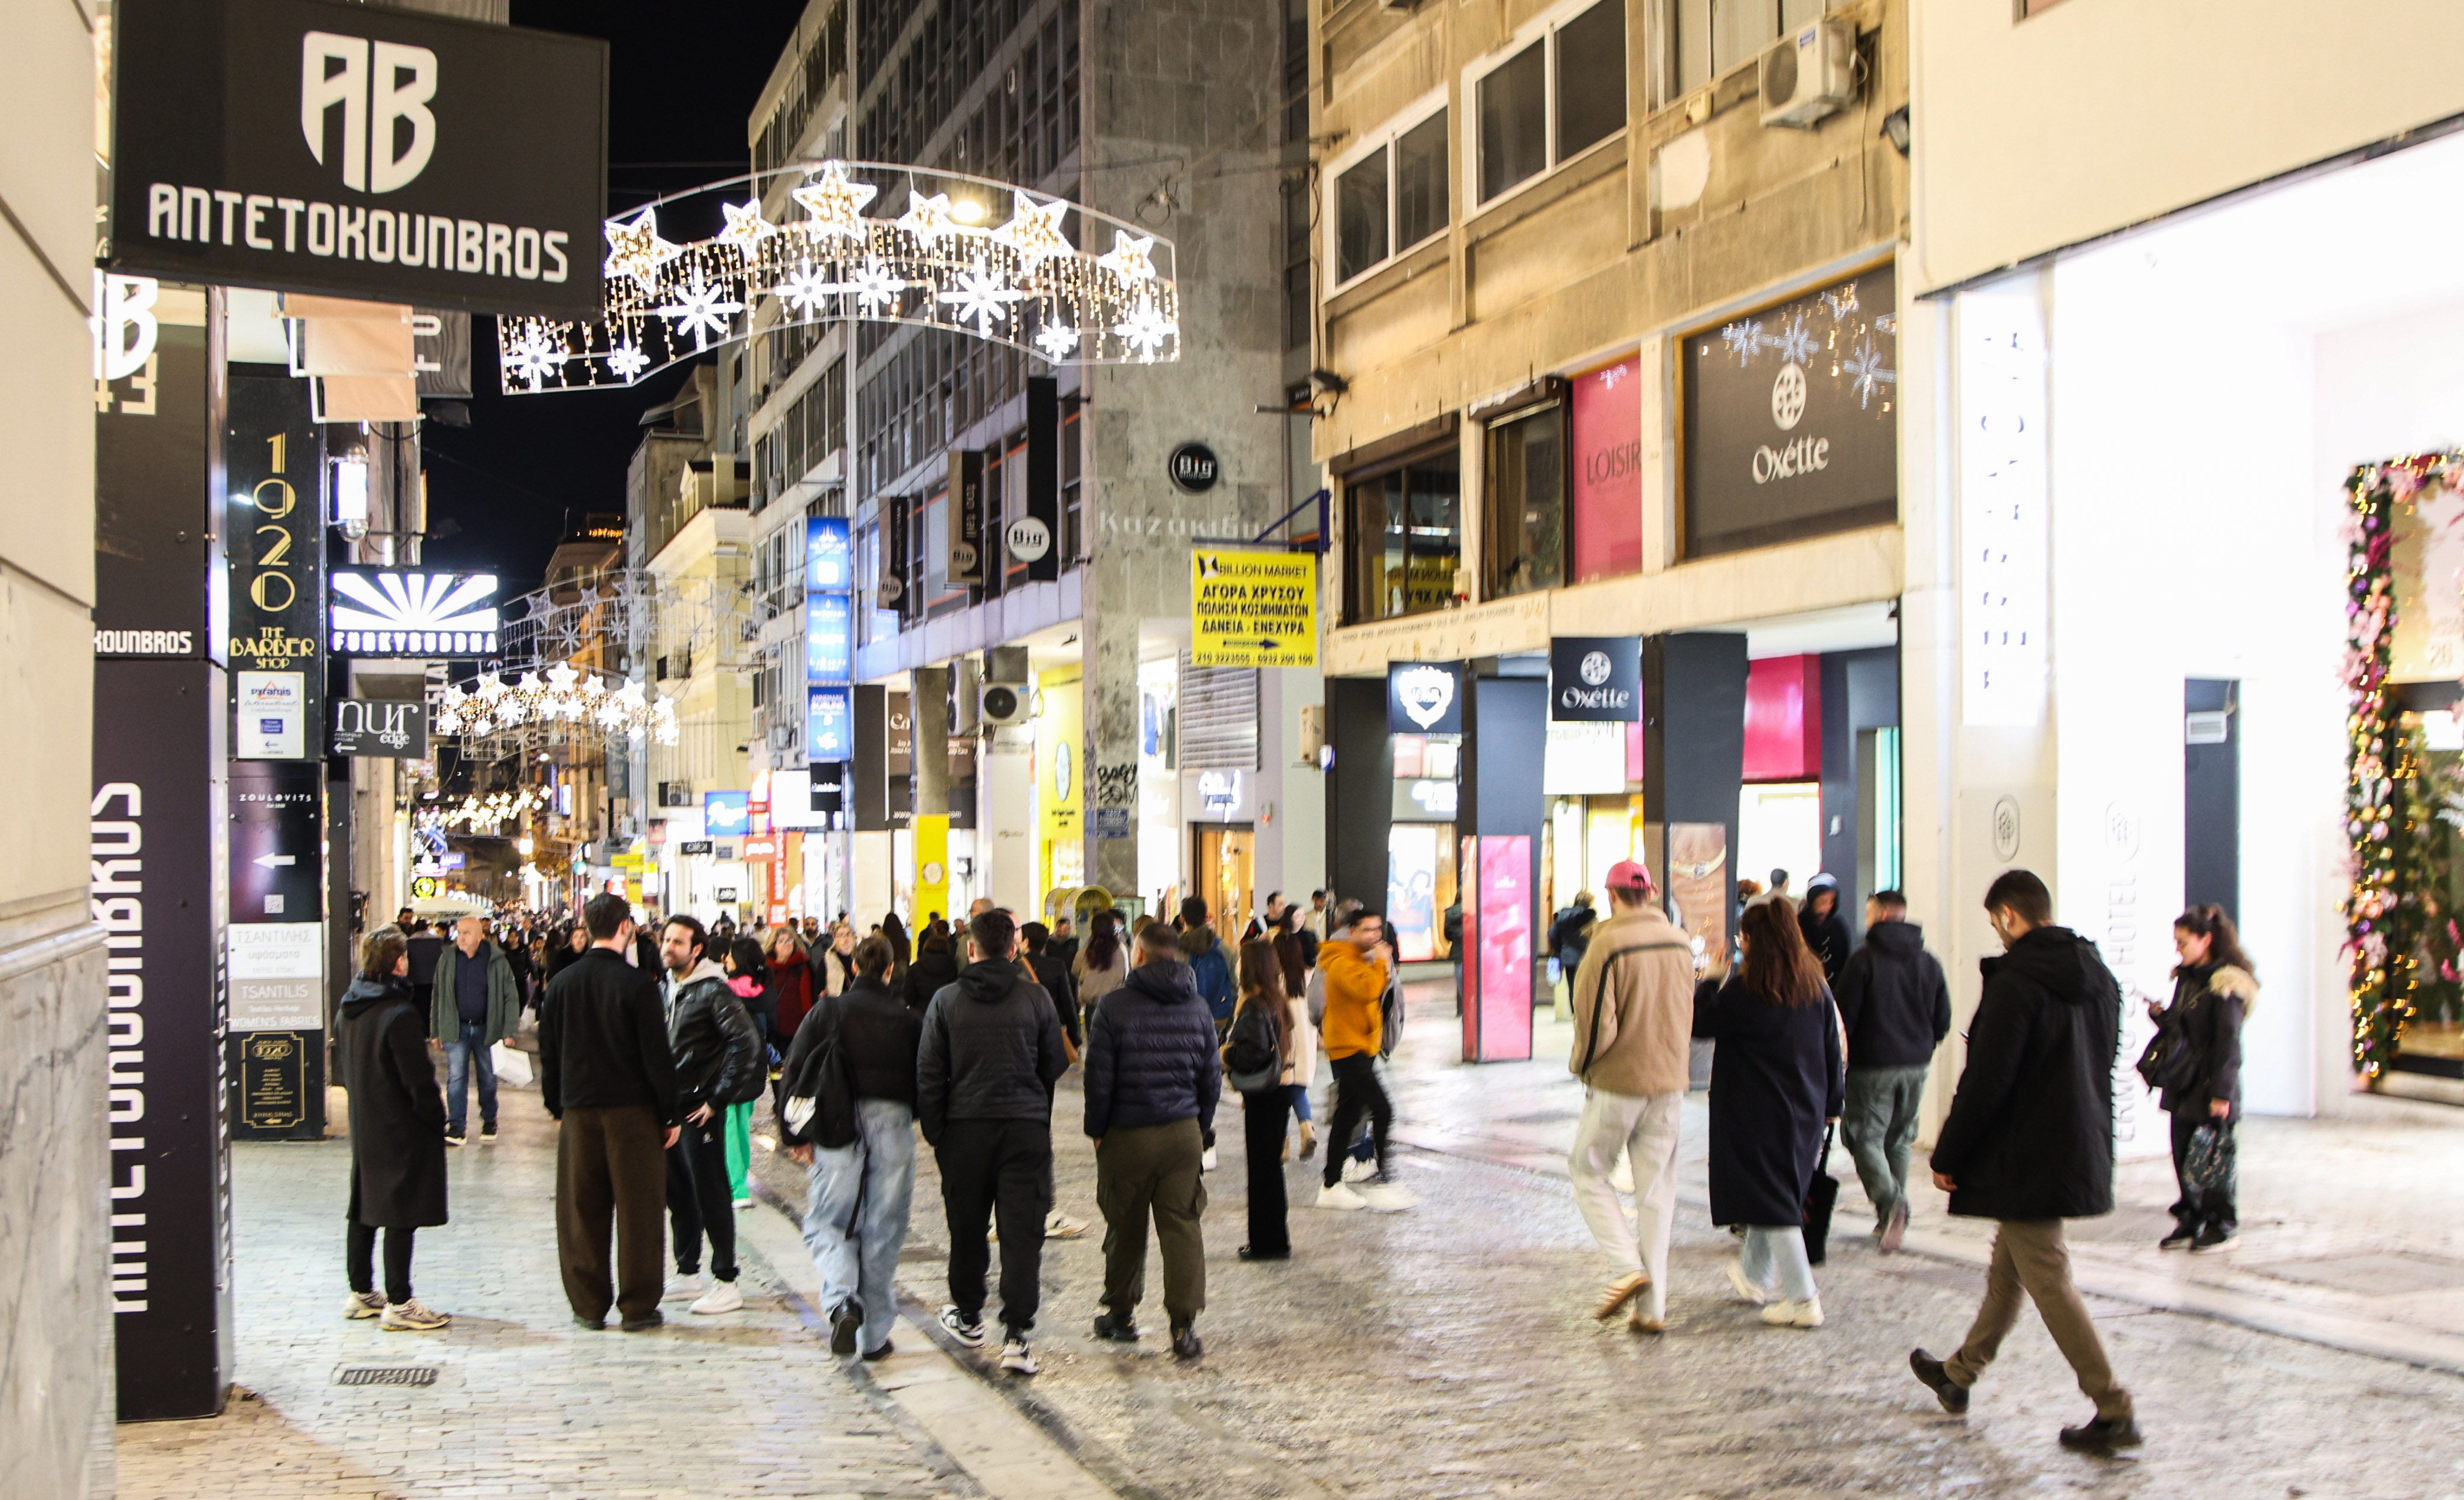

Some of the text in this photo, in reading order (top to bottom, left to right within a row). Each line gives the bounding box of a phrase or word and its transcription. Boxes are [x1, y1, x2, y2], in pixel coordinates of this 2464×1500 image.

[302, 31, 437, 194] AB
[149, 183, 569, 283] ANTETOKOUNBROS
[1586, 438, 1642, 486] LOISIR
[1752, 434, 1830, 485] Oxétte
[252, 432, 296, 612] 1920
[1220, 563, 1307, 579] BILLION MARKET
[1203, 583, 1305, 601] ΑΓΟΡΑ ΧΡΥΣΟΥ
[260, 626, 285, 638] THE
[1202, 619, 1305, 636] ΔΑΝΕΙΑ ΕΝΕΧΥΡΑ
[230, 637, 315, 657] BARBER
[255, 657, 290, 669] SHOP
[251, 686, 291, 696] pyramis
[1560, 686, 1630, 709] Oxétte
[337, 700, 419, 735] nur
[379, 731, 411, 750] edge
[239, 794, 312, 802] ZOULOVITS
[2108, 873, 2136, 972] HOTEL
[236, 930, 312, 944] ΤΣΑΝΤΙΛΗΣ
[241, 984, 309, 999] TSANTILIS
[280, 1015, 320, 1026] FABRICS
